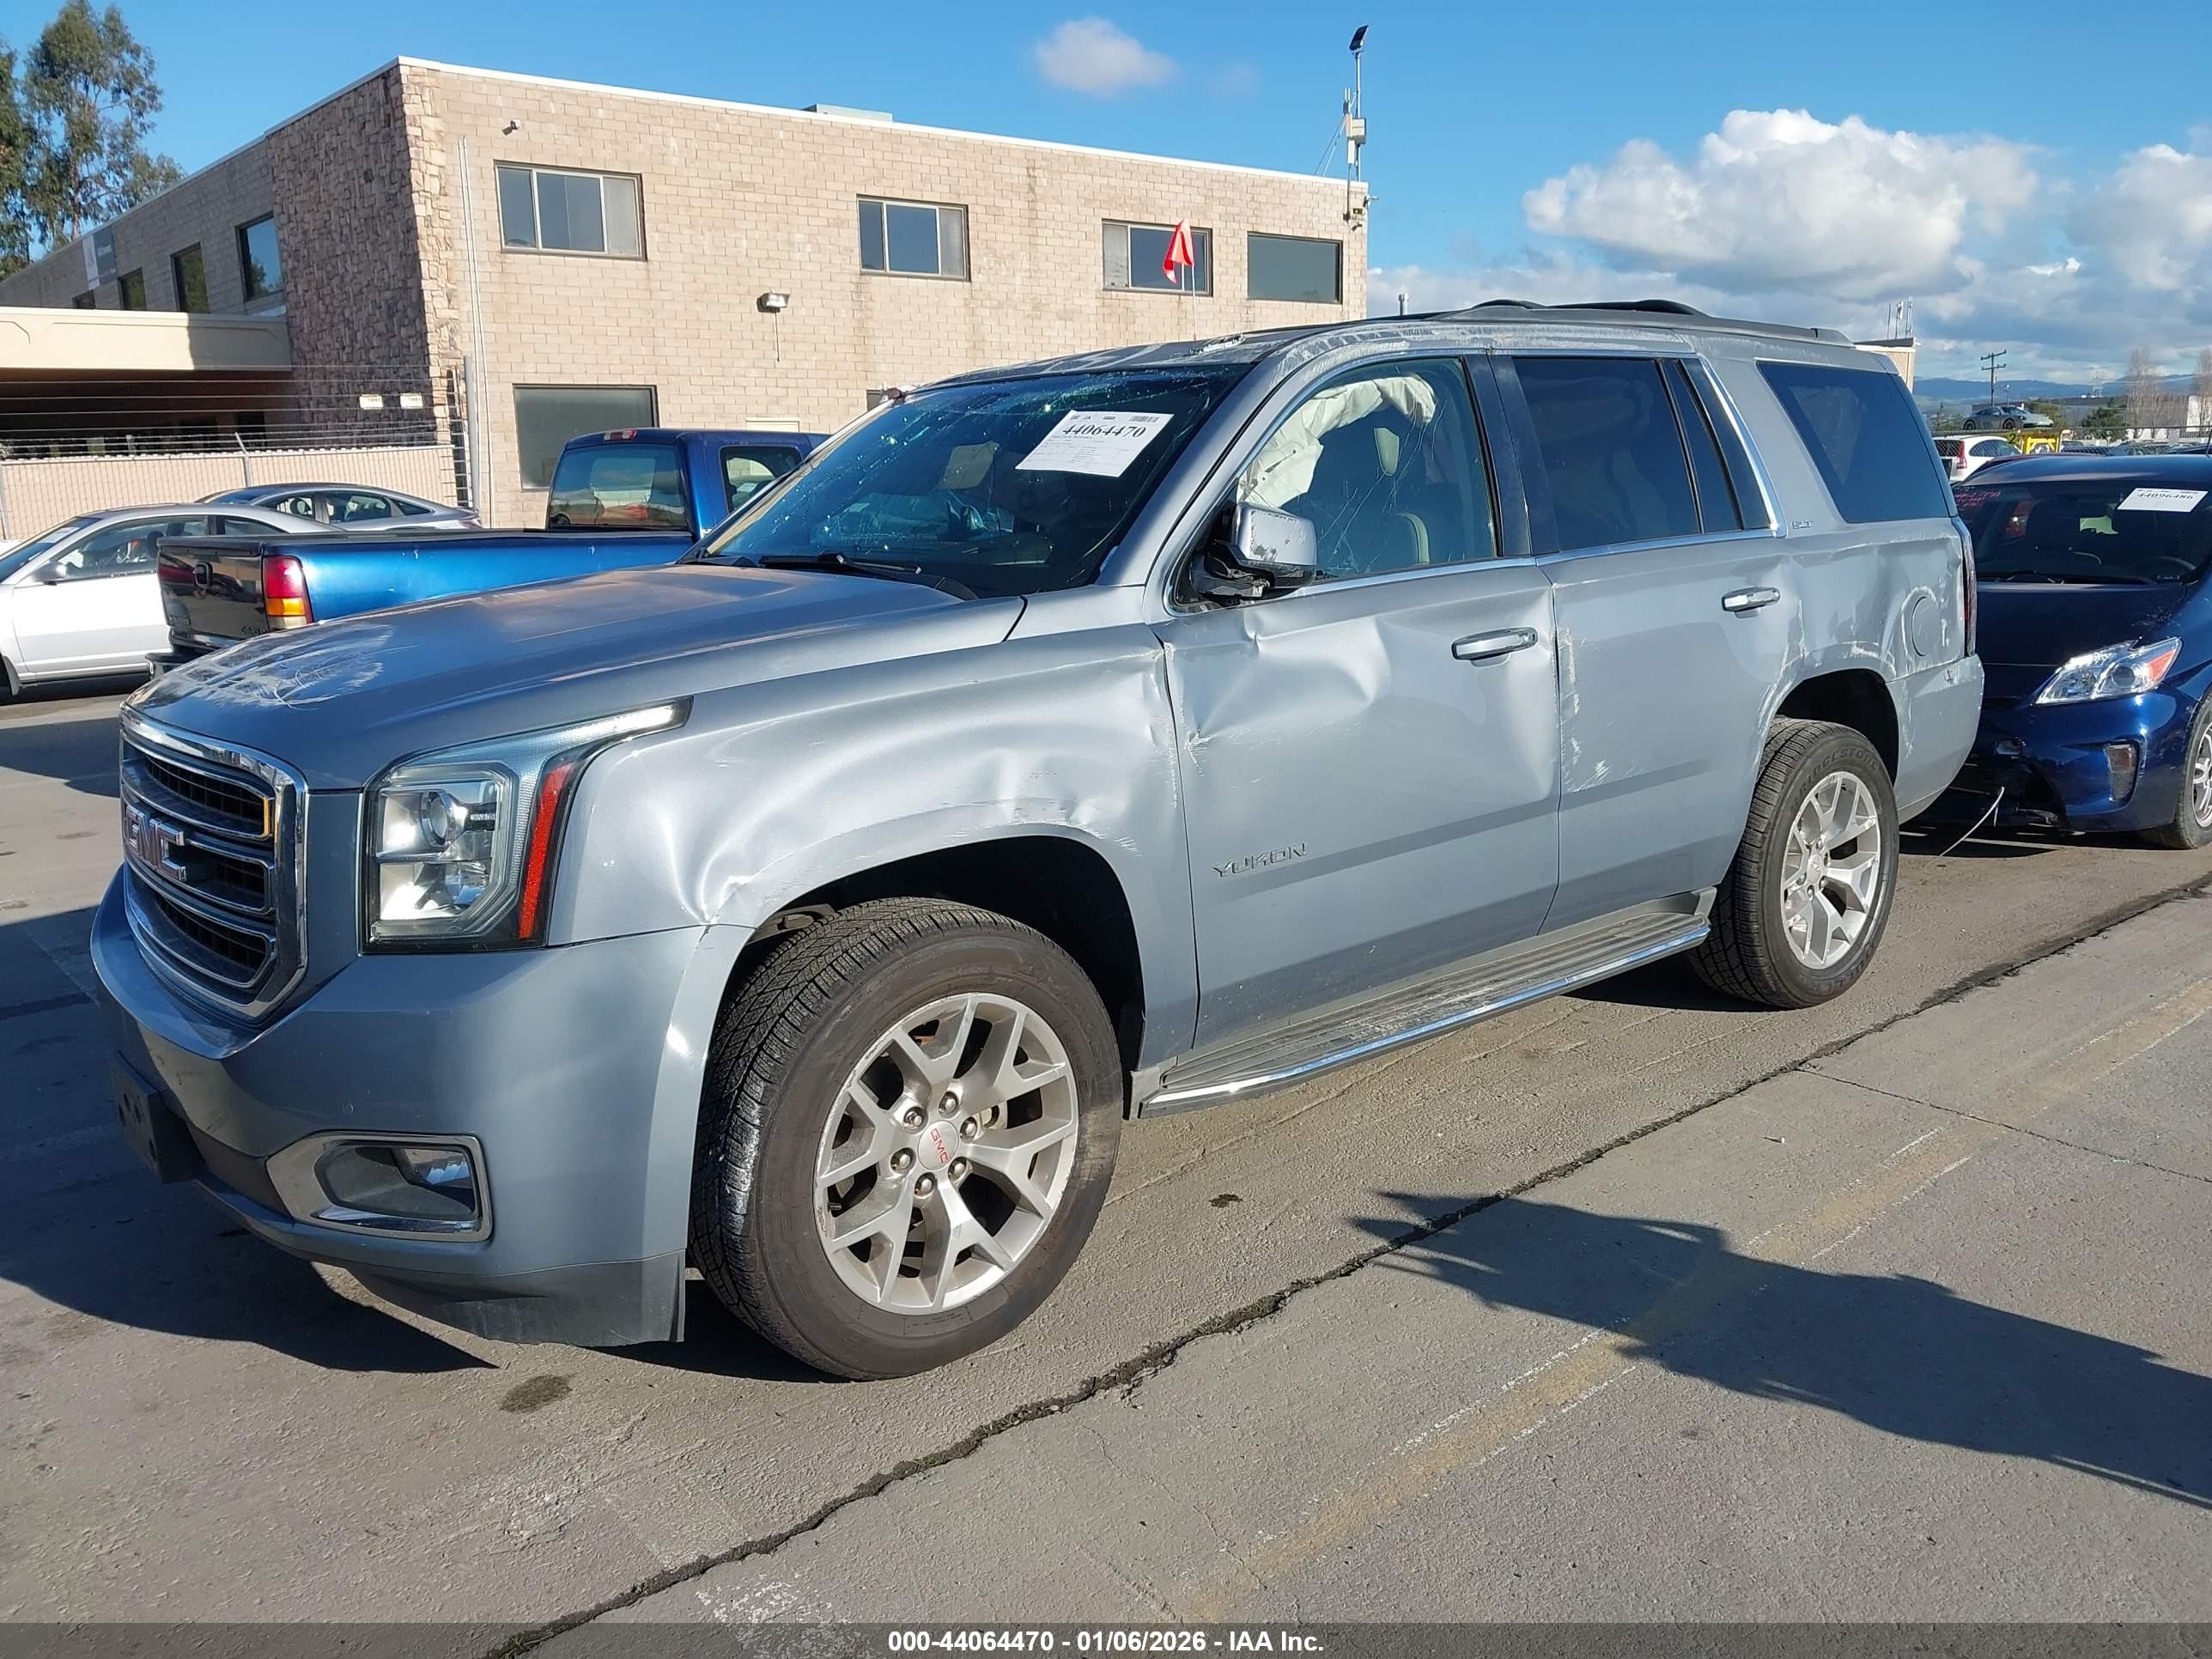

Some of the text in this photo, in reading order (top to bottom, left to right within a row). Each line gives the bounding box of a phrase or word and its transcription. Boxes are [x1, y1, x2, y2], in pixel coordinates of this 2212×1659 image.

[1062, 424, 1147, 439] 44064470
[2008, 433, 2016, 444] 2
[125, 804, 187, 882] GMC
[1211, 842, 1306, 878] YUKON
[930, 1127, 949, 1164] GMC
